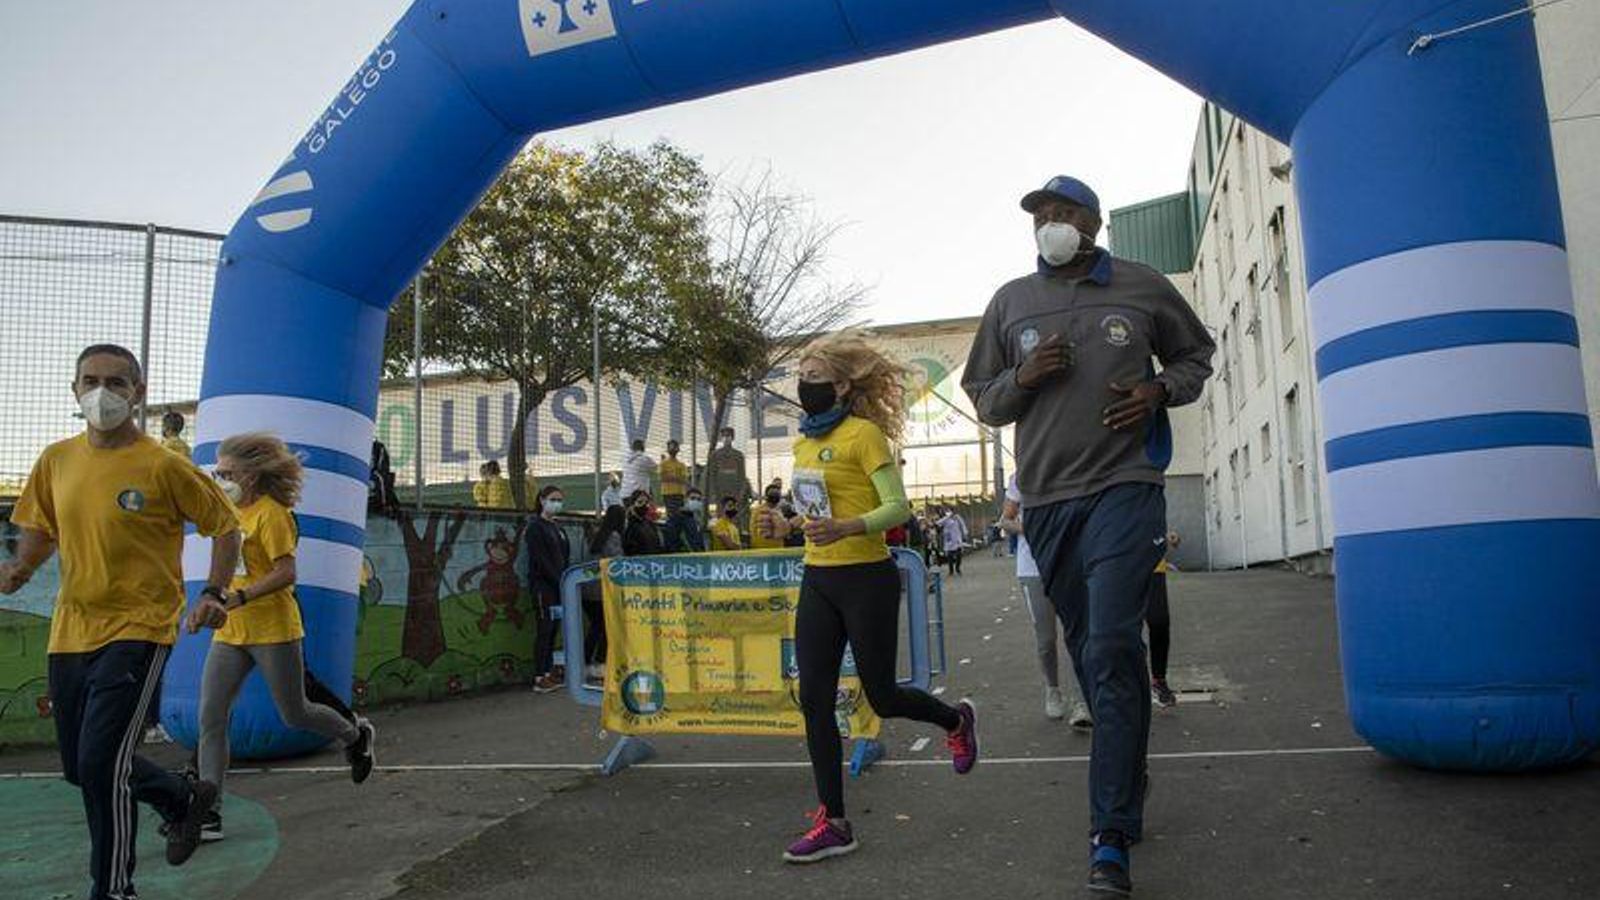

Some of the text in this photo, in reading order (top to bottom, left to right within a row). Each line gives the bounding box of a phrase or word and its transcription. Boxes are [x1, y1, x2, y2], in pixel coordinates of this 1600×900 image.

[308, 49, 397, 154] GALEGO
[440, 386, 588, 463] LUIS
[615, 366, 789, 446] VIVE
